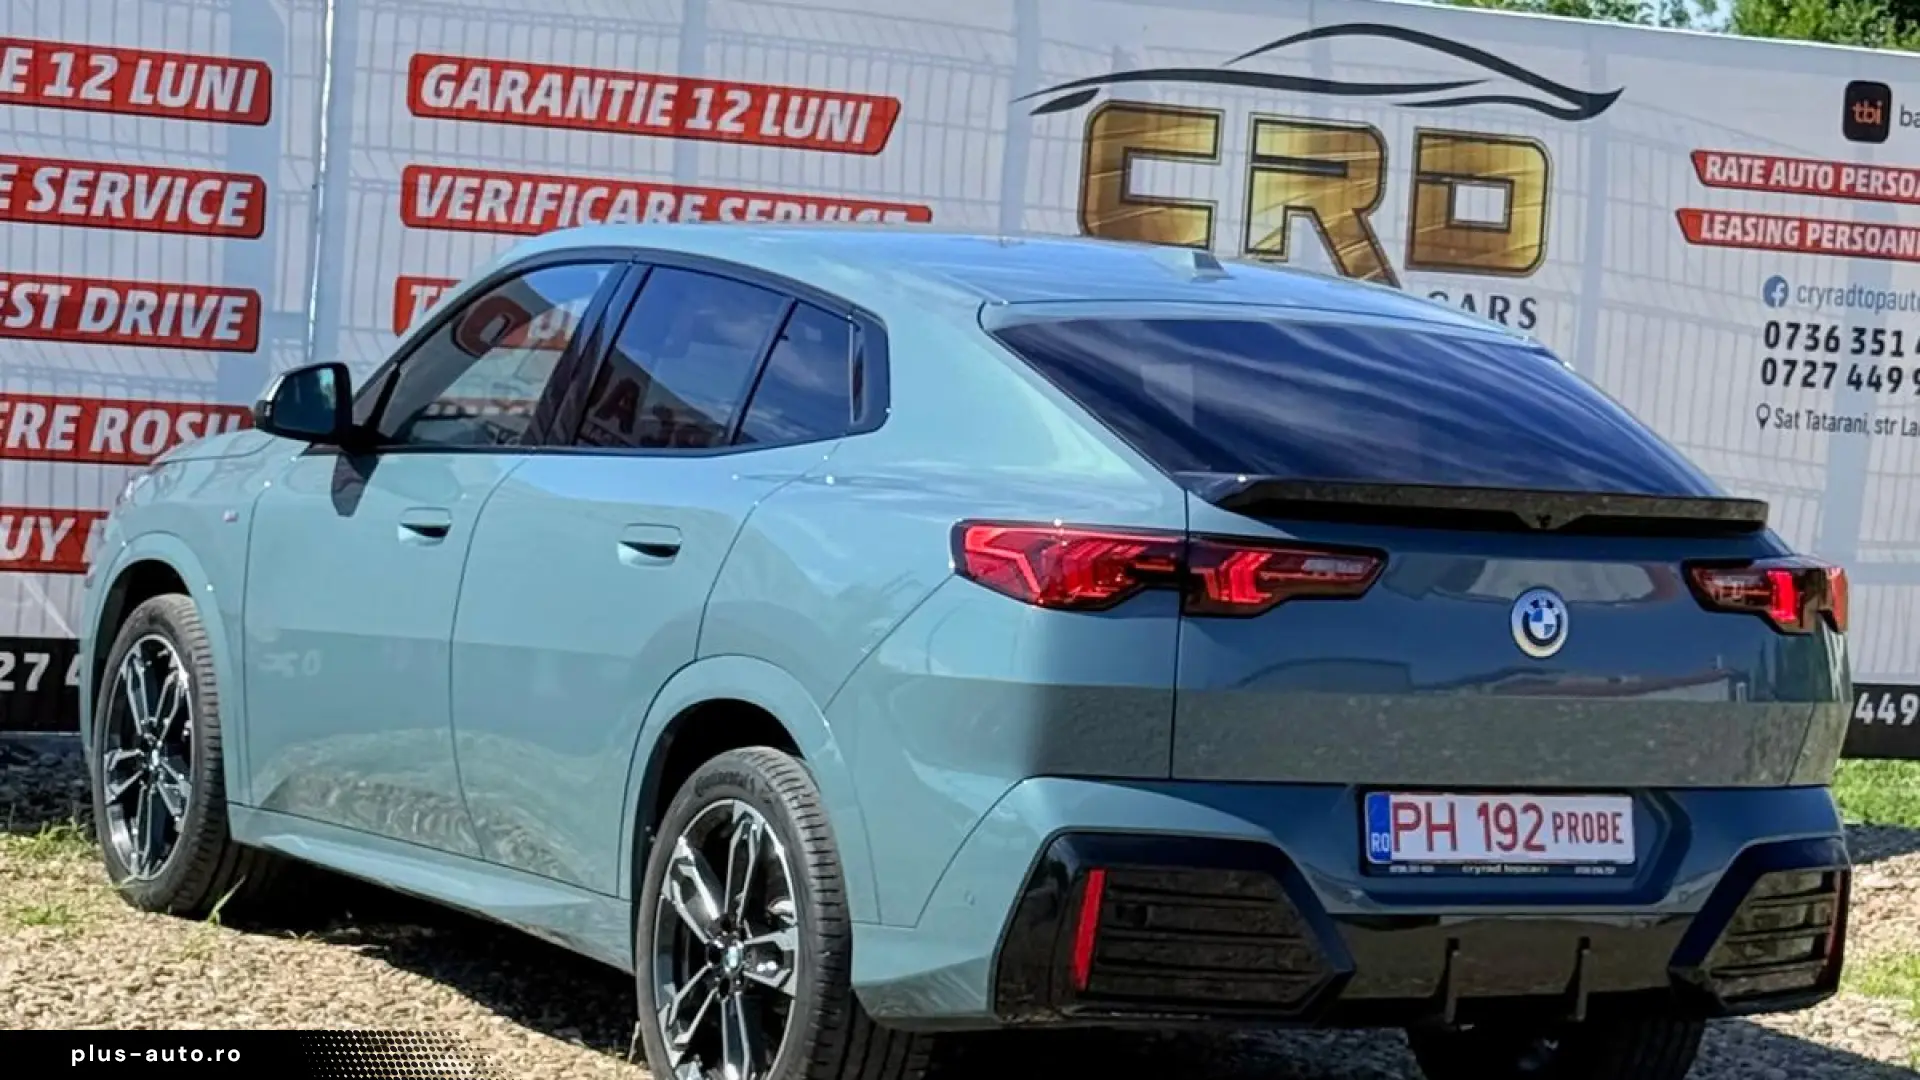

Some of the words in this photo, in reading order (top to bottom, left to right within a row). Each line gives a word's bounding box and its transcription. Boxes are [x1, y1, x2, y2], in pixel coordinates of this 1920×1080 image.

[43, 51, 119, 101] 12
[129, 58, 260, 114] LUNI
[420, 62, 679, 128] GARANTIE
[684, 86, 749, 135] 12
[759, 92, 874, 146] LUNI
[1852, 100, 1882, 125] tbi
[25, 166, 253, 229] SERVICE
[1704, 154, 1766, 185] RATE
[1768, 160, 1835, 190] AUTO
[1839, 168, 1920, 199] PERSO
[415, 173, 707, 227] VERIFICARE
[1701, 212, 1801, 246] LEASING
[1805, 217, 1920, 257] PERSOAN
[77, 286, 248, 343] DRIVE
[1796, 283, 1920, 315] cryradtopaut
[1764, 319, 1841, 353] 0736
[1850, 327, 1905, 358] 351
[1761, 356, 1838, 390] 0727
[1846, 362, 1904, 394] 449
[1773, 407, 1800, 430] Sat
[1805, 409, 1870, 437] Tatarani,
[1874, 416, 1898, 436] str
[1901, 415, 1920, 438] La
[1854, 691, 1920, 727] 449
[1371, 832, 1391, 853] RO
[1391, 801, 1458, 852] PH
[1477, 801, 1547, 852] 192
[1551, 811, 1625, 844] PROBE
